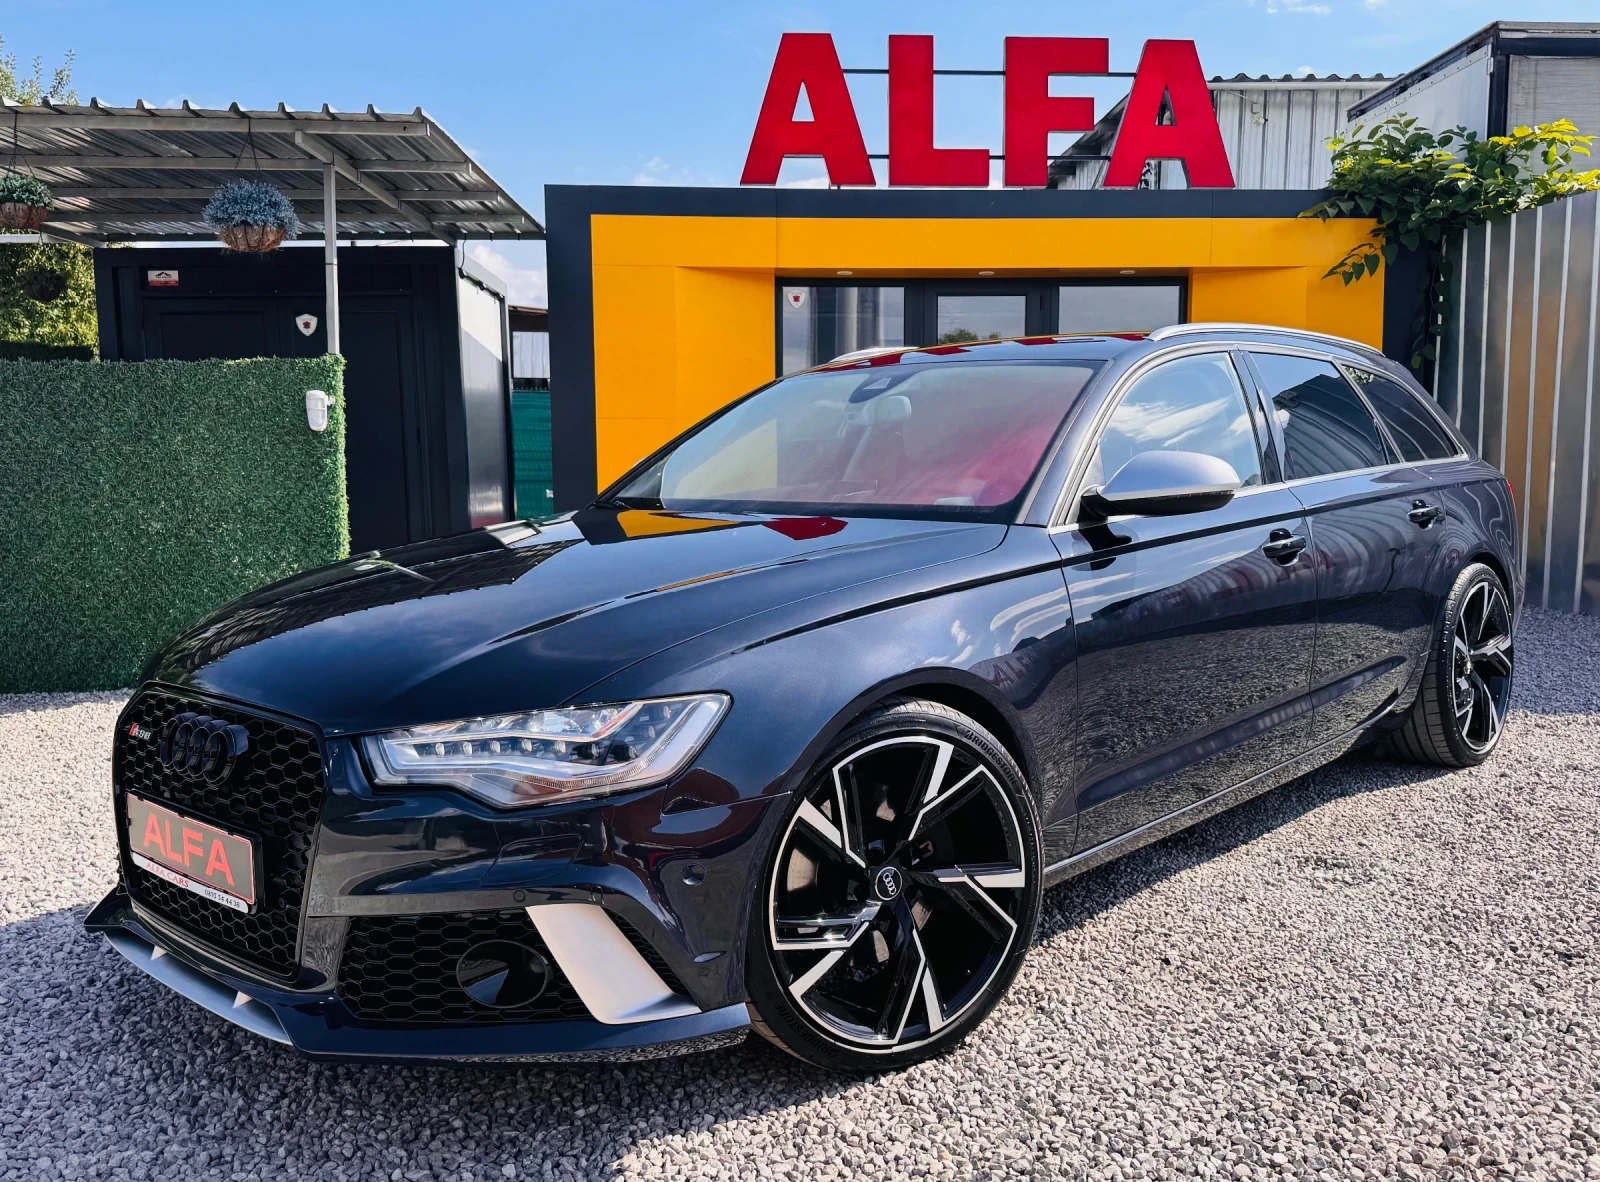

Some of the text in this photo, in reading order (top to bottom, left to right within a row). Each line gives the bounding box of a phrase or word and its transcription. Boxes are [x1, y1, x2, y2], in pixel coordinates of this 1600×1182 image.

[740, 33, 1235, 188] ALFA
[963, 729, 1020, 788] BRIDGESTONE
[143, 812, 235, 887] ALFA
[146, 862, 189, 888] ALFA CARS
